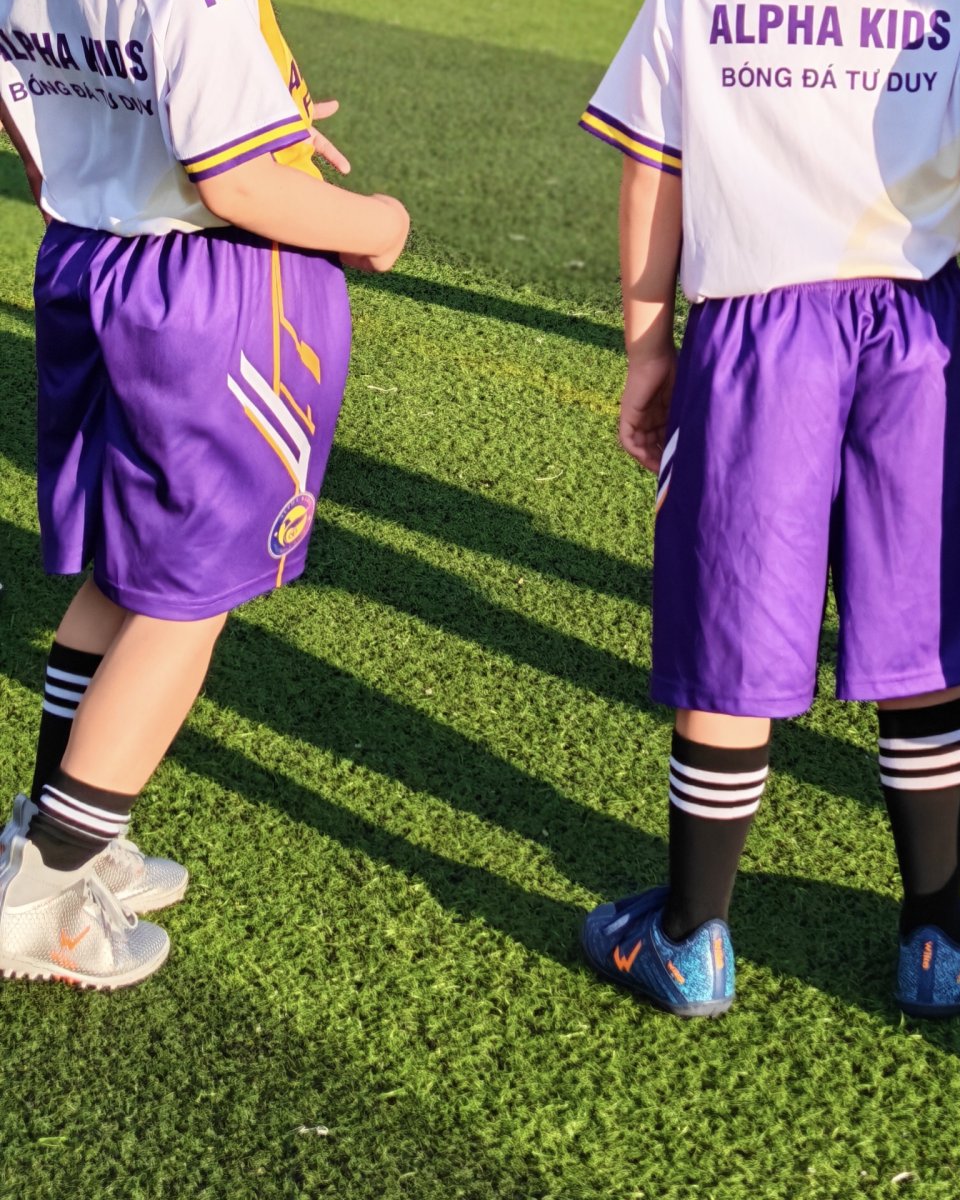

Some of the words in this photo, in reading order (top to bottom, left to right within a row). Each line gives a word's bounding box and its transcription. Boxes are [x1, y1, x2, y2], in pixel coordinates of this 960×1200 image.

[710, 3, 843, 46] ALPHA
[859, 7, 951, 51] KIDS
[81, 35, 148, 81] KIDS
[722, 61, 792, 88] BÓNG
[802, 64, 837, 89] ĐÁ
[846, 69, 880, 91] TƯ
[887, 72, 938, 93] DUY
[9, 74, 71, 102] BÓNG
